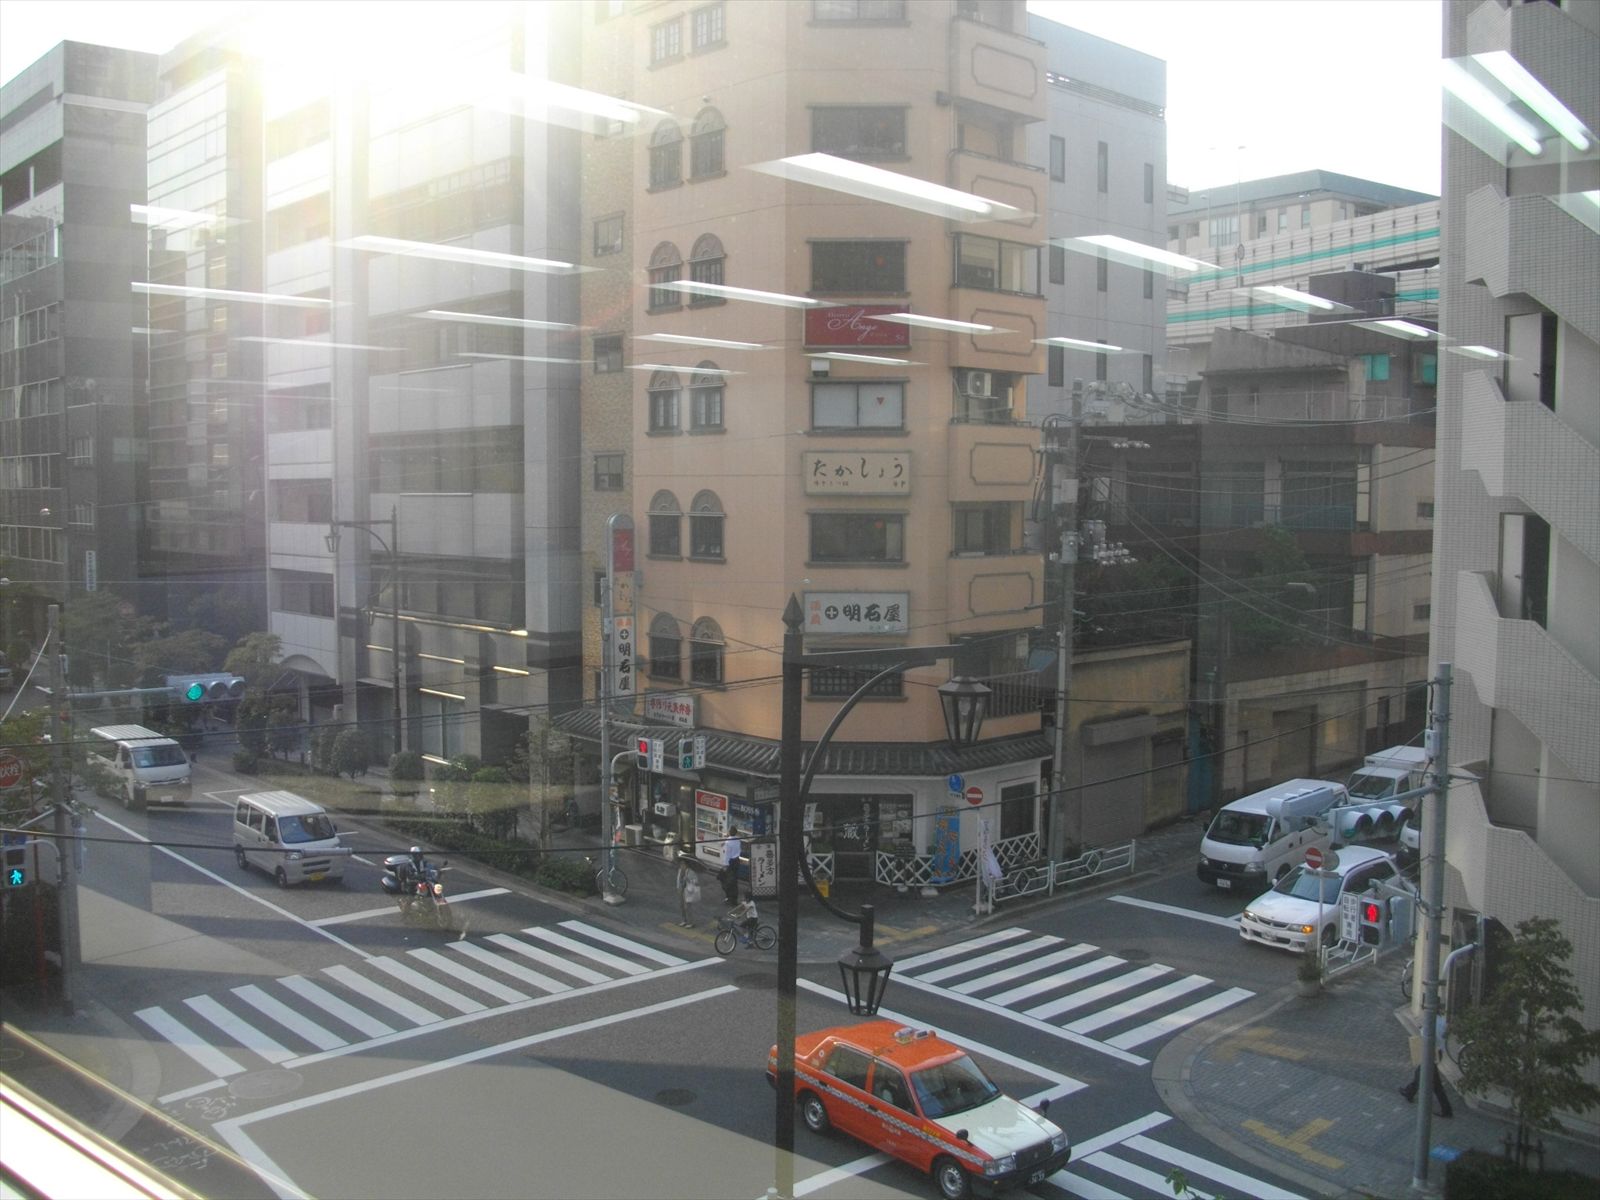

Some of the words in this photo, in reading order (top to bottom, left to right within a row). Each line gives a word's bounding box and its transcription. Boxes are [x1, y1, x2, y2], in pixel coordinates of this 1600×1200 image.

[813, 457, 903, 478] たかしょう
[842, 603, 901, 622] 明石屋
[618, 642, 631, 690] 明石屋
